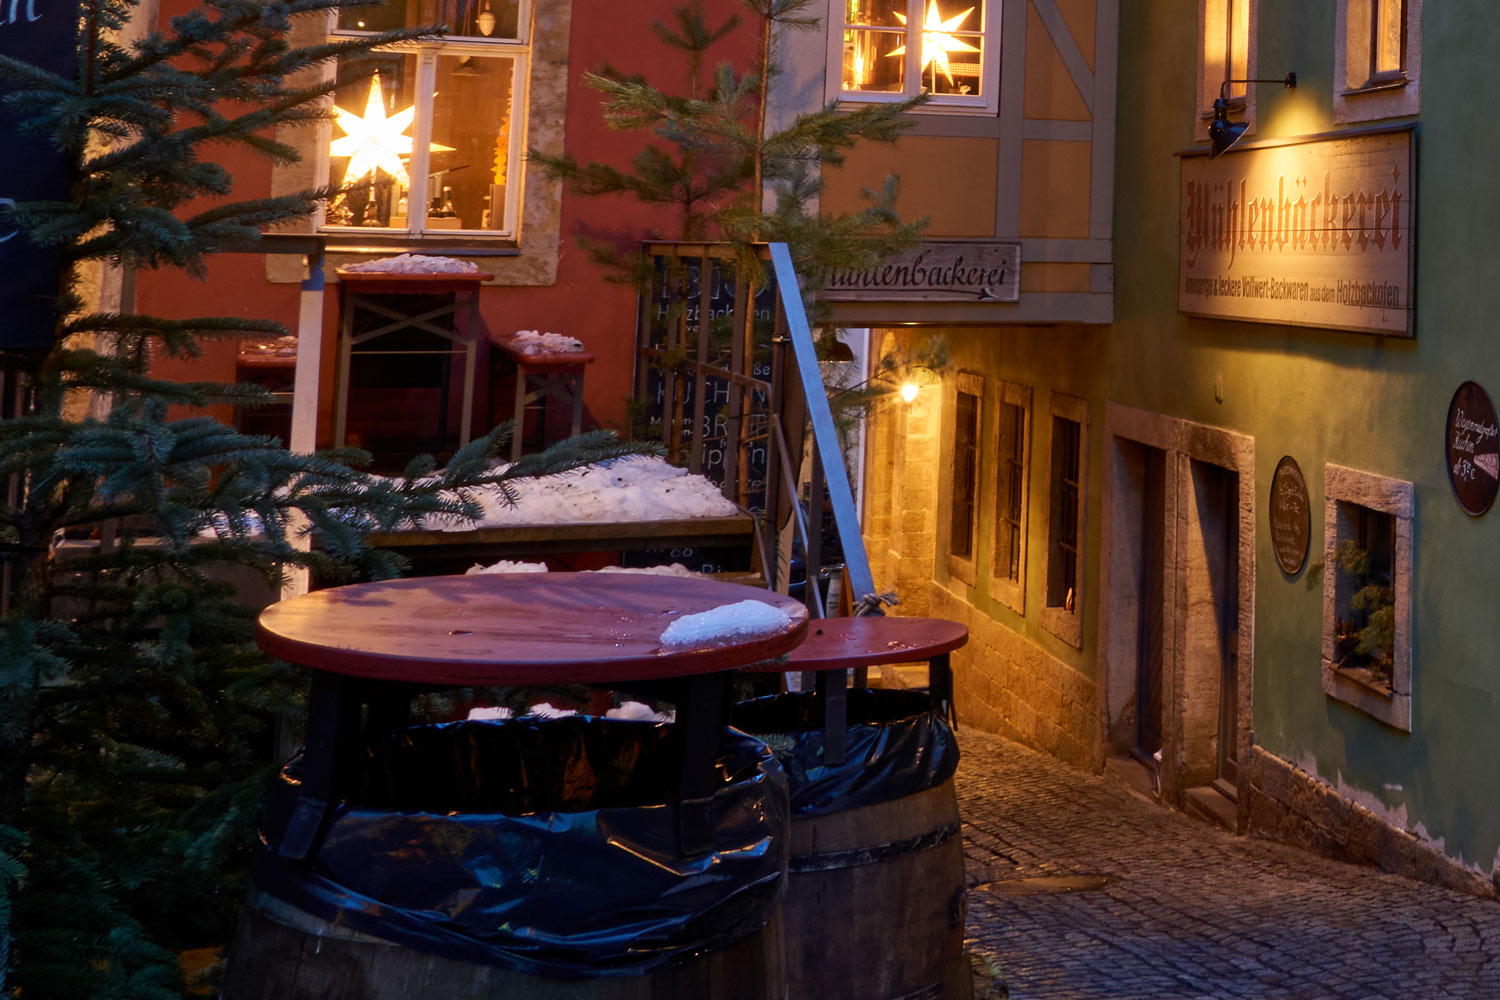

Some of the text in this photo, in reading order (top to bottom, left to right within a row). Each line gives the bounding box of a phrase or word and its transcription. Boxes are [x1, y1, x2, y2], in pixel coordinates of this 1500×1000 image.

[1186, 164, 1402, 270] Mühlenbäckerei
[1219, 276, 1241, 297] leckere
[1242, 276, 1308, 301] Vollwert-Backwaren
[1310, 288, 1320, 301] aus
[1321, 288, 1335, 303] dem
[1337, 280, 1399, 307] Holzbackofen
